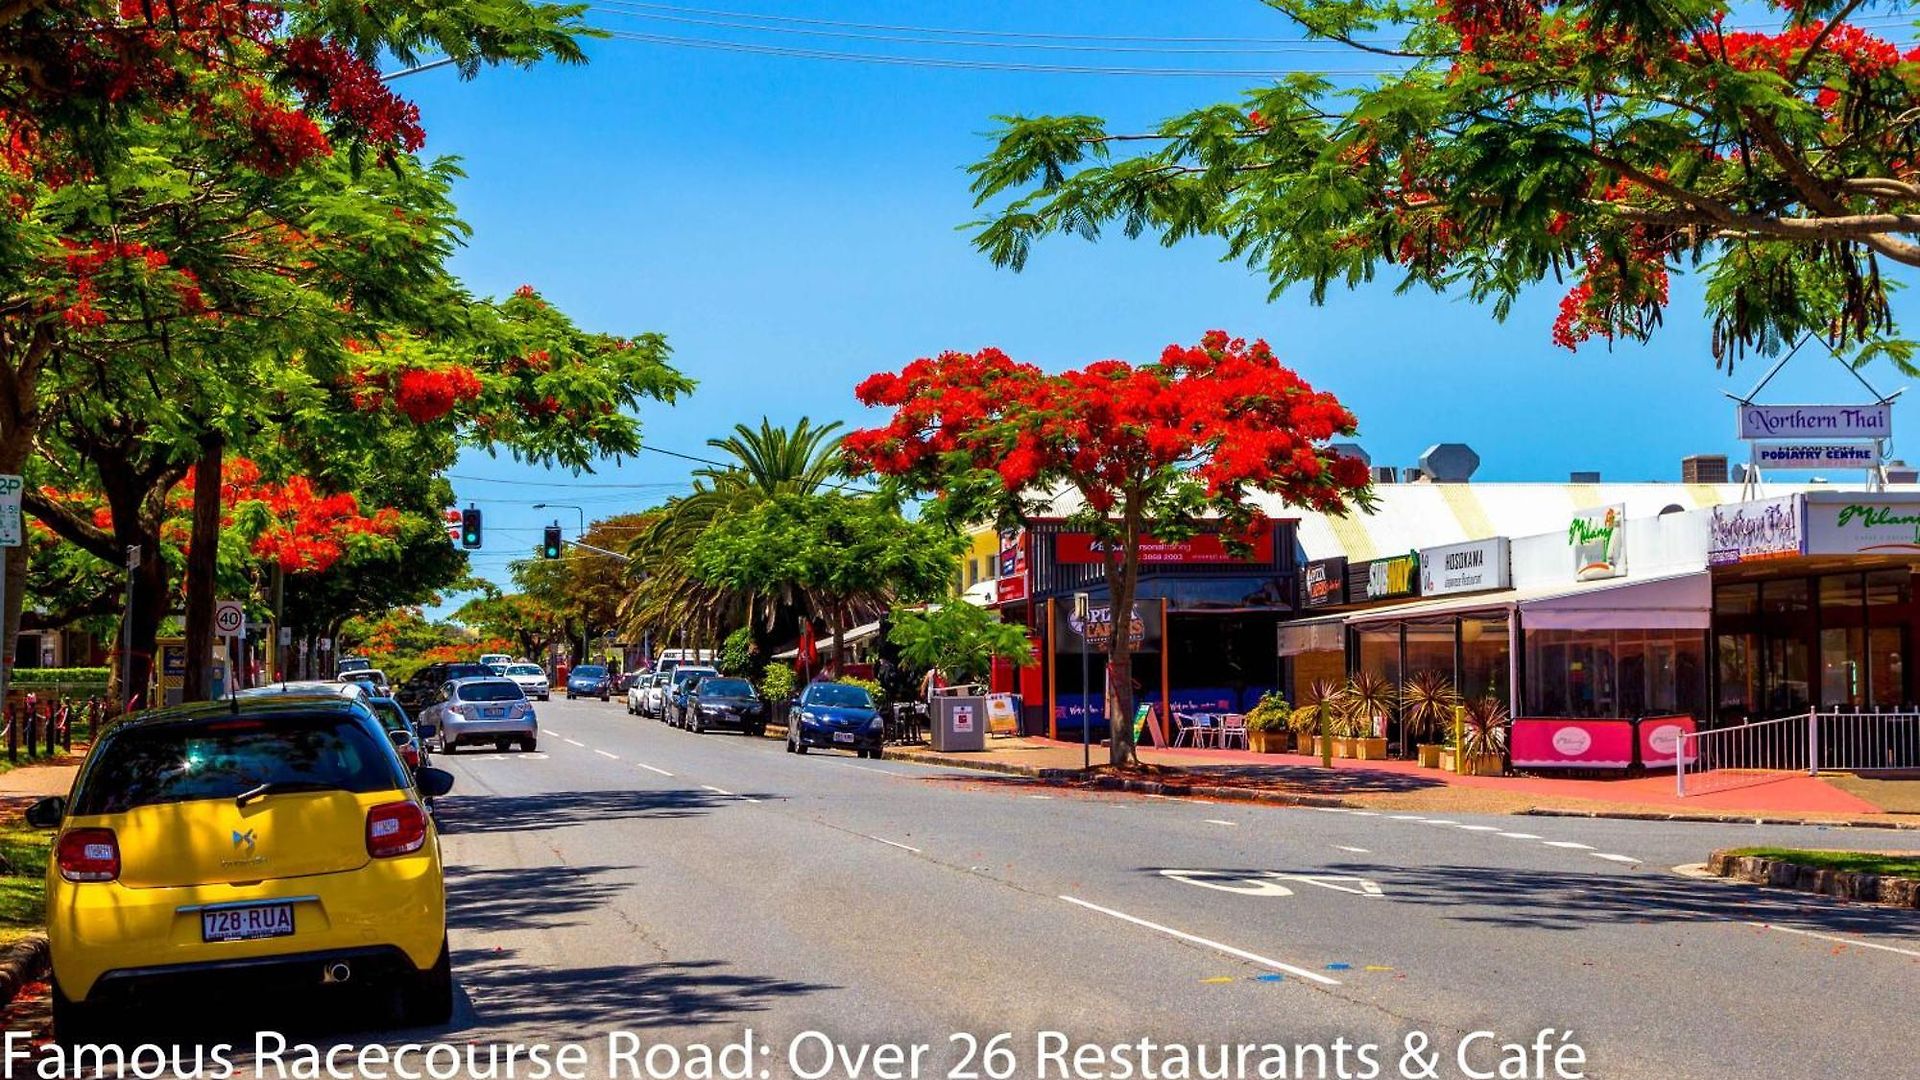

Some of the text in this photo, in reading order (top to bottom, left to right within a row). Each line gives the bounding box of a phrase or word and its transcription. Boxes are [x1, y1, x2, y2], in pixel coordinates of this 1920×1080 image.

[1749, 410, 1884, 435] Northern Thai
[1761, 450, 1871, 460] PODIATRY CENTRE
[1445, 550, 1483, 571] HOSOKAWA
[1367, 558, 1414, 598] SUBWAY
[220, 612, 239, 626] 40
